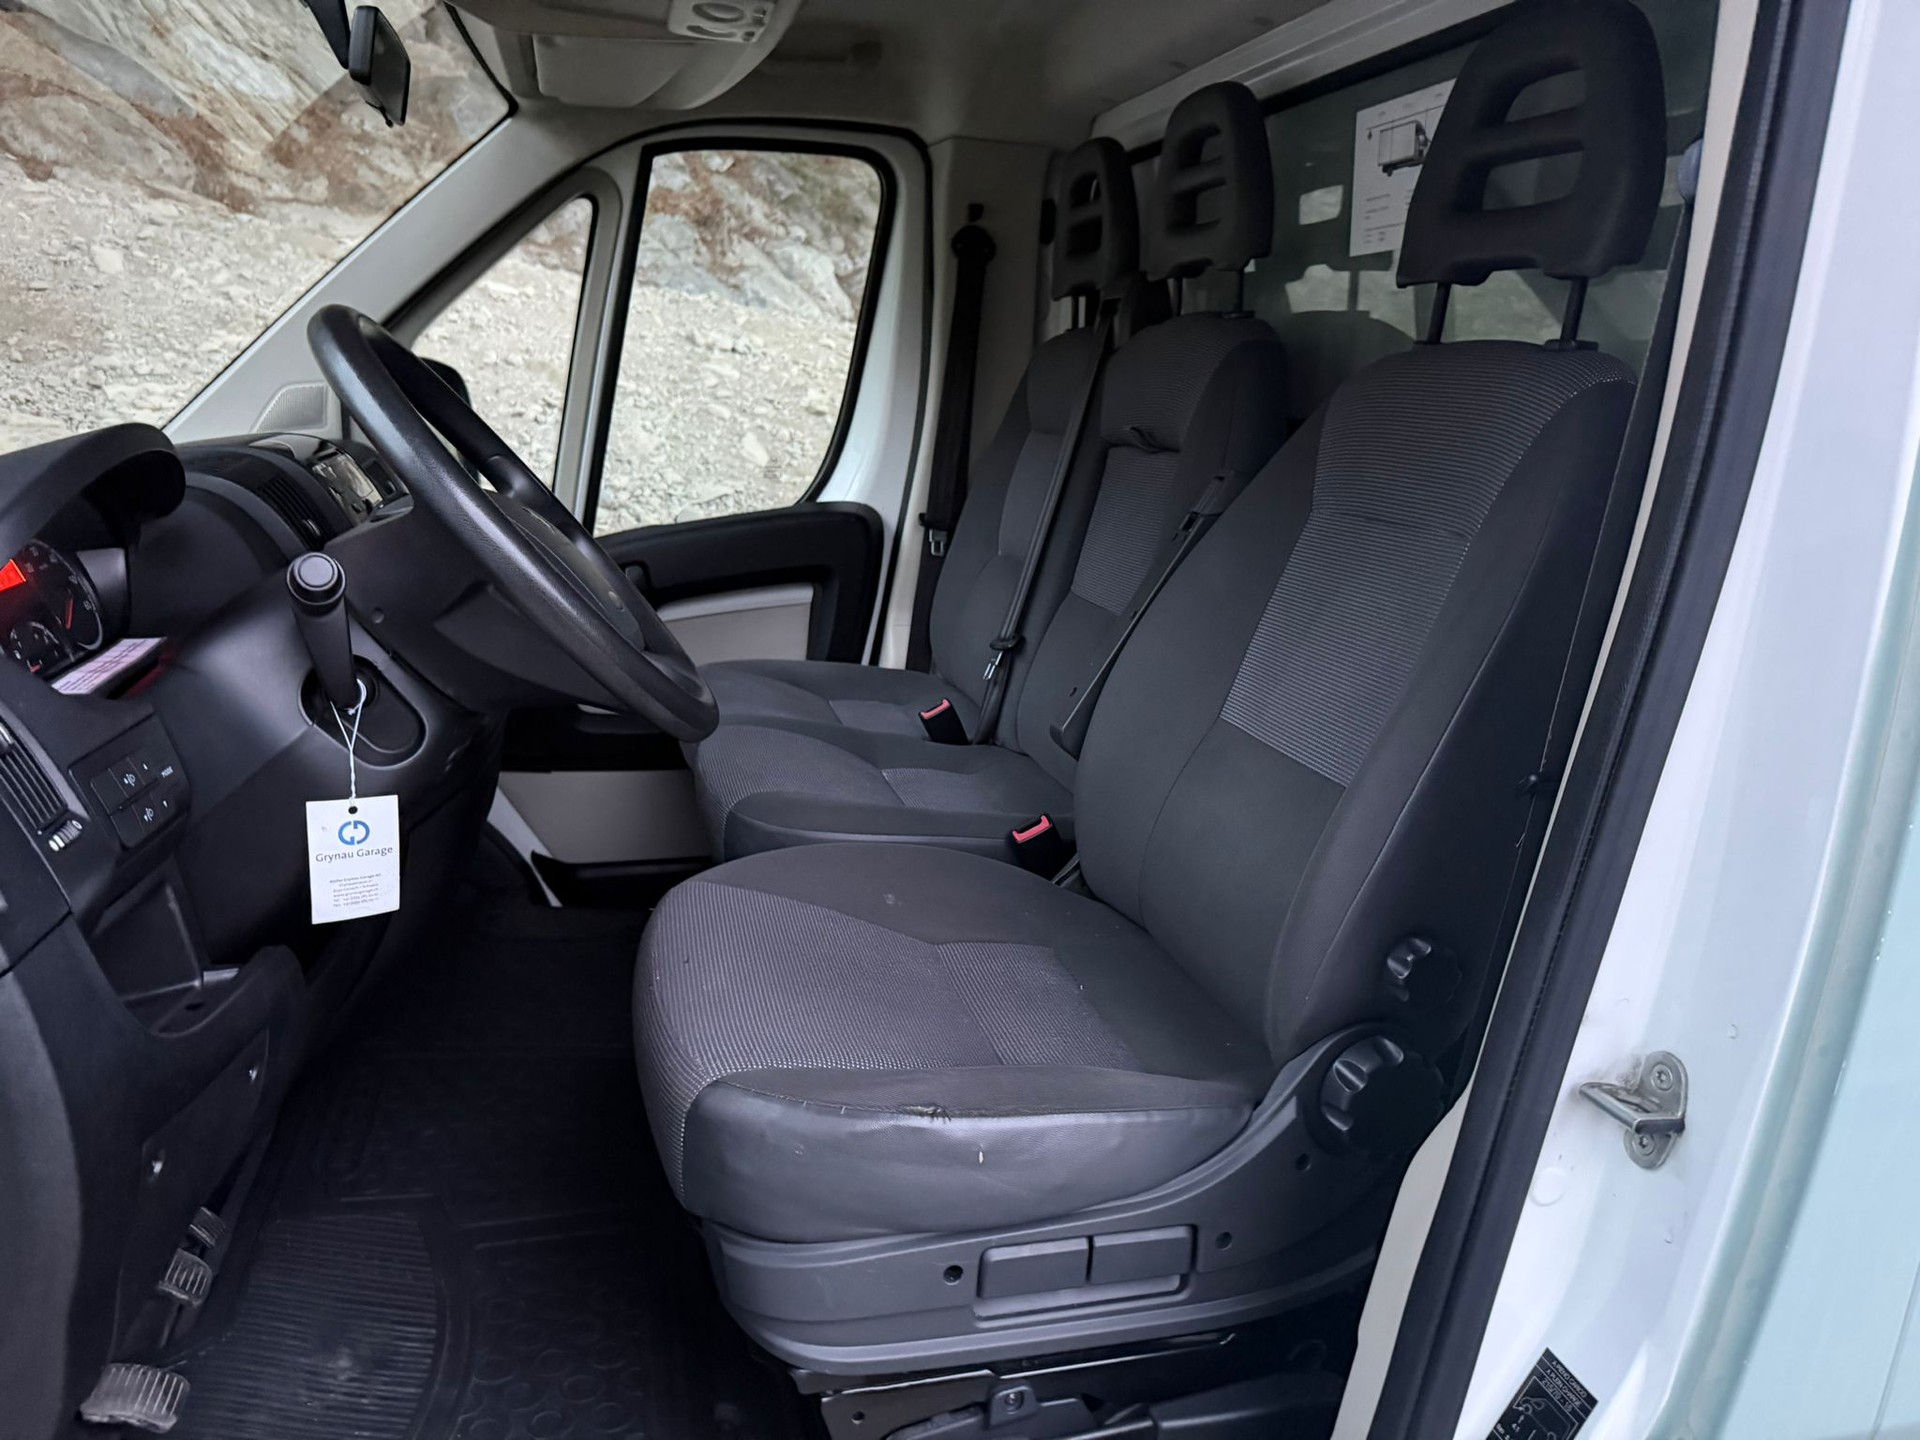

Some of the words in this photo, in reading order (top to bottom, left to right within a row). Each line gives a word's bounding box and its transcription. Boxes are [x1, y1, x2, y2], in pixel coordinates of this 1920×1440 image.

[315, 850, 354, 863] Grynau
[356, 847, 393, 857] Garage
[1569, 1376, 1588, 1398] CARICO
